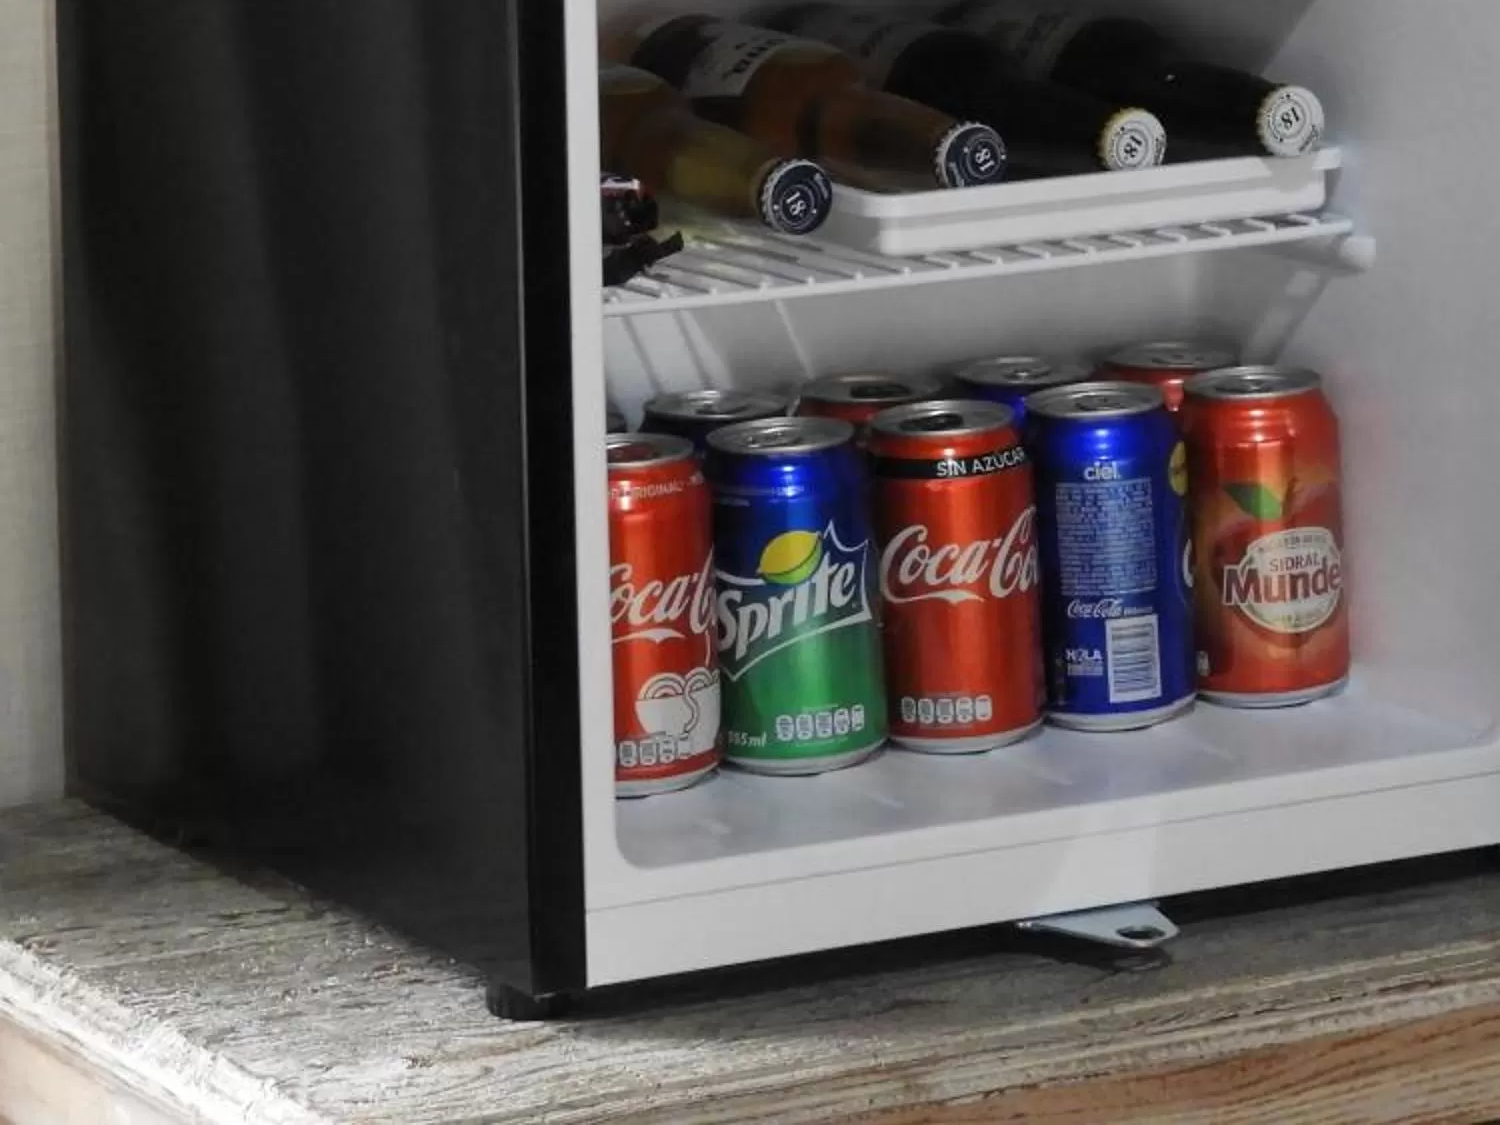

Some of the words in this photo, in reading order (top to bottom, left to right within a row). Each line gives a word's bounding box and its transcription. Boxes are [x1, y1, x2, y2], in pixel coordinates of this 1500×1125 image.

[936, 459, 968, 477] SIN
[1269, 553, 1321, 572] SIDRAL
[1224, 557, 1342, 604] Munde
[716, 551, 857, 662] Sprite
